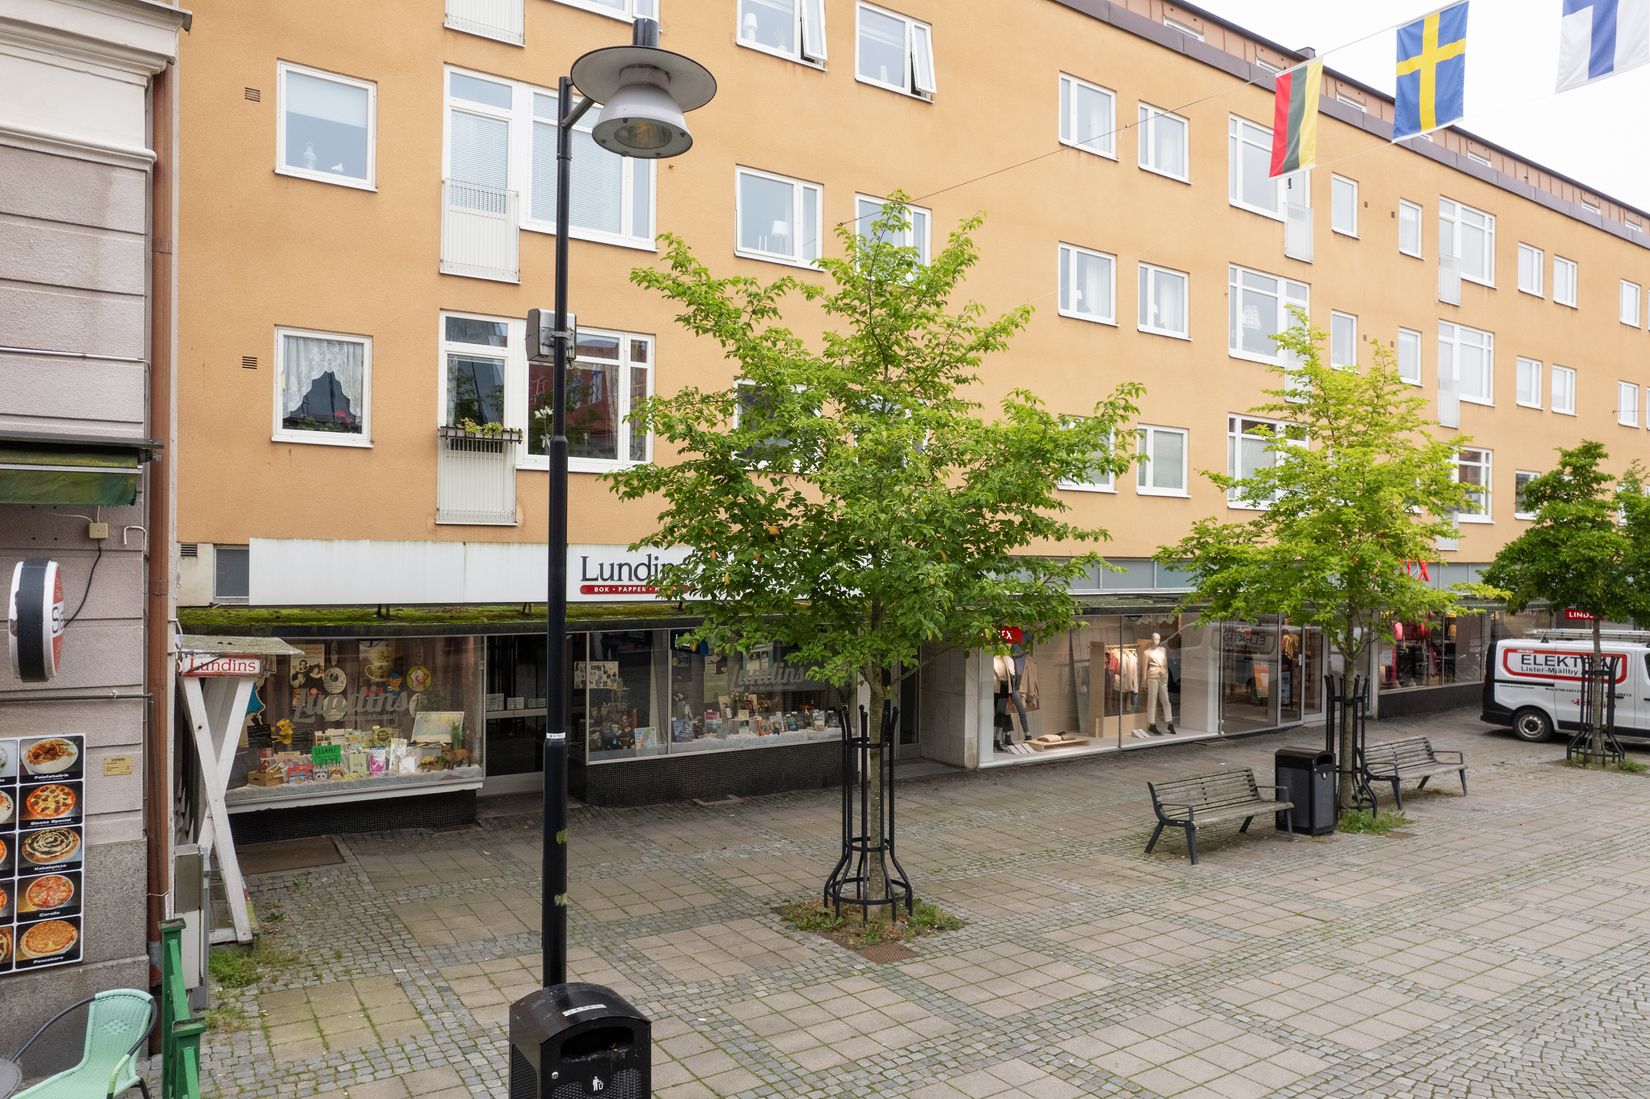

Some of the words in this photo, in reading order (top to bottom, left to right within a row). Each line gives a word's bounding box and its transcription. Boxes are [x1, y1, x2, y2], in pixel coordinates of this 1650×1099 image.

[580, 553, 685, 582] Lundin
[1569, 611, 1595, 619] LIND
[189, 656, 256, 672] Lundins
[293, 686, 408, 723] Lundins
